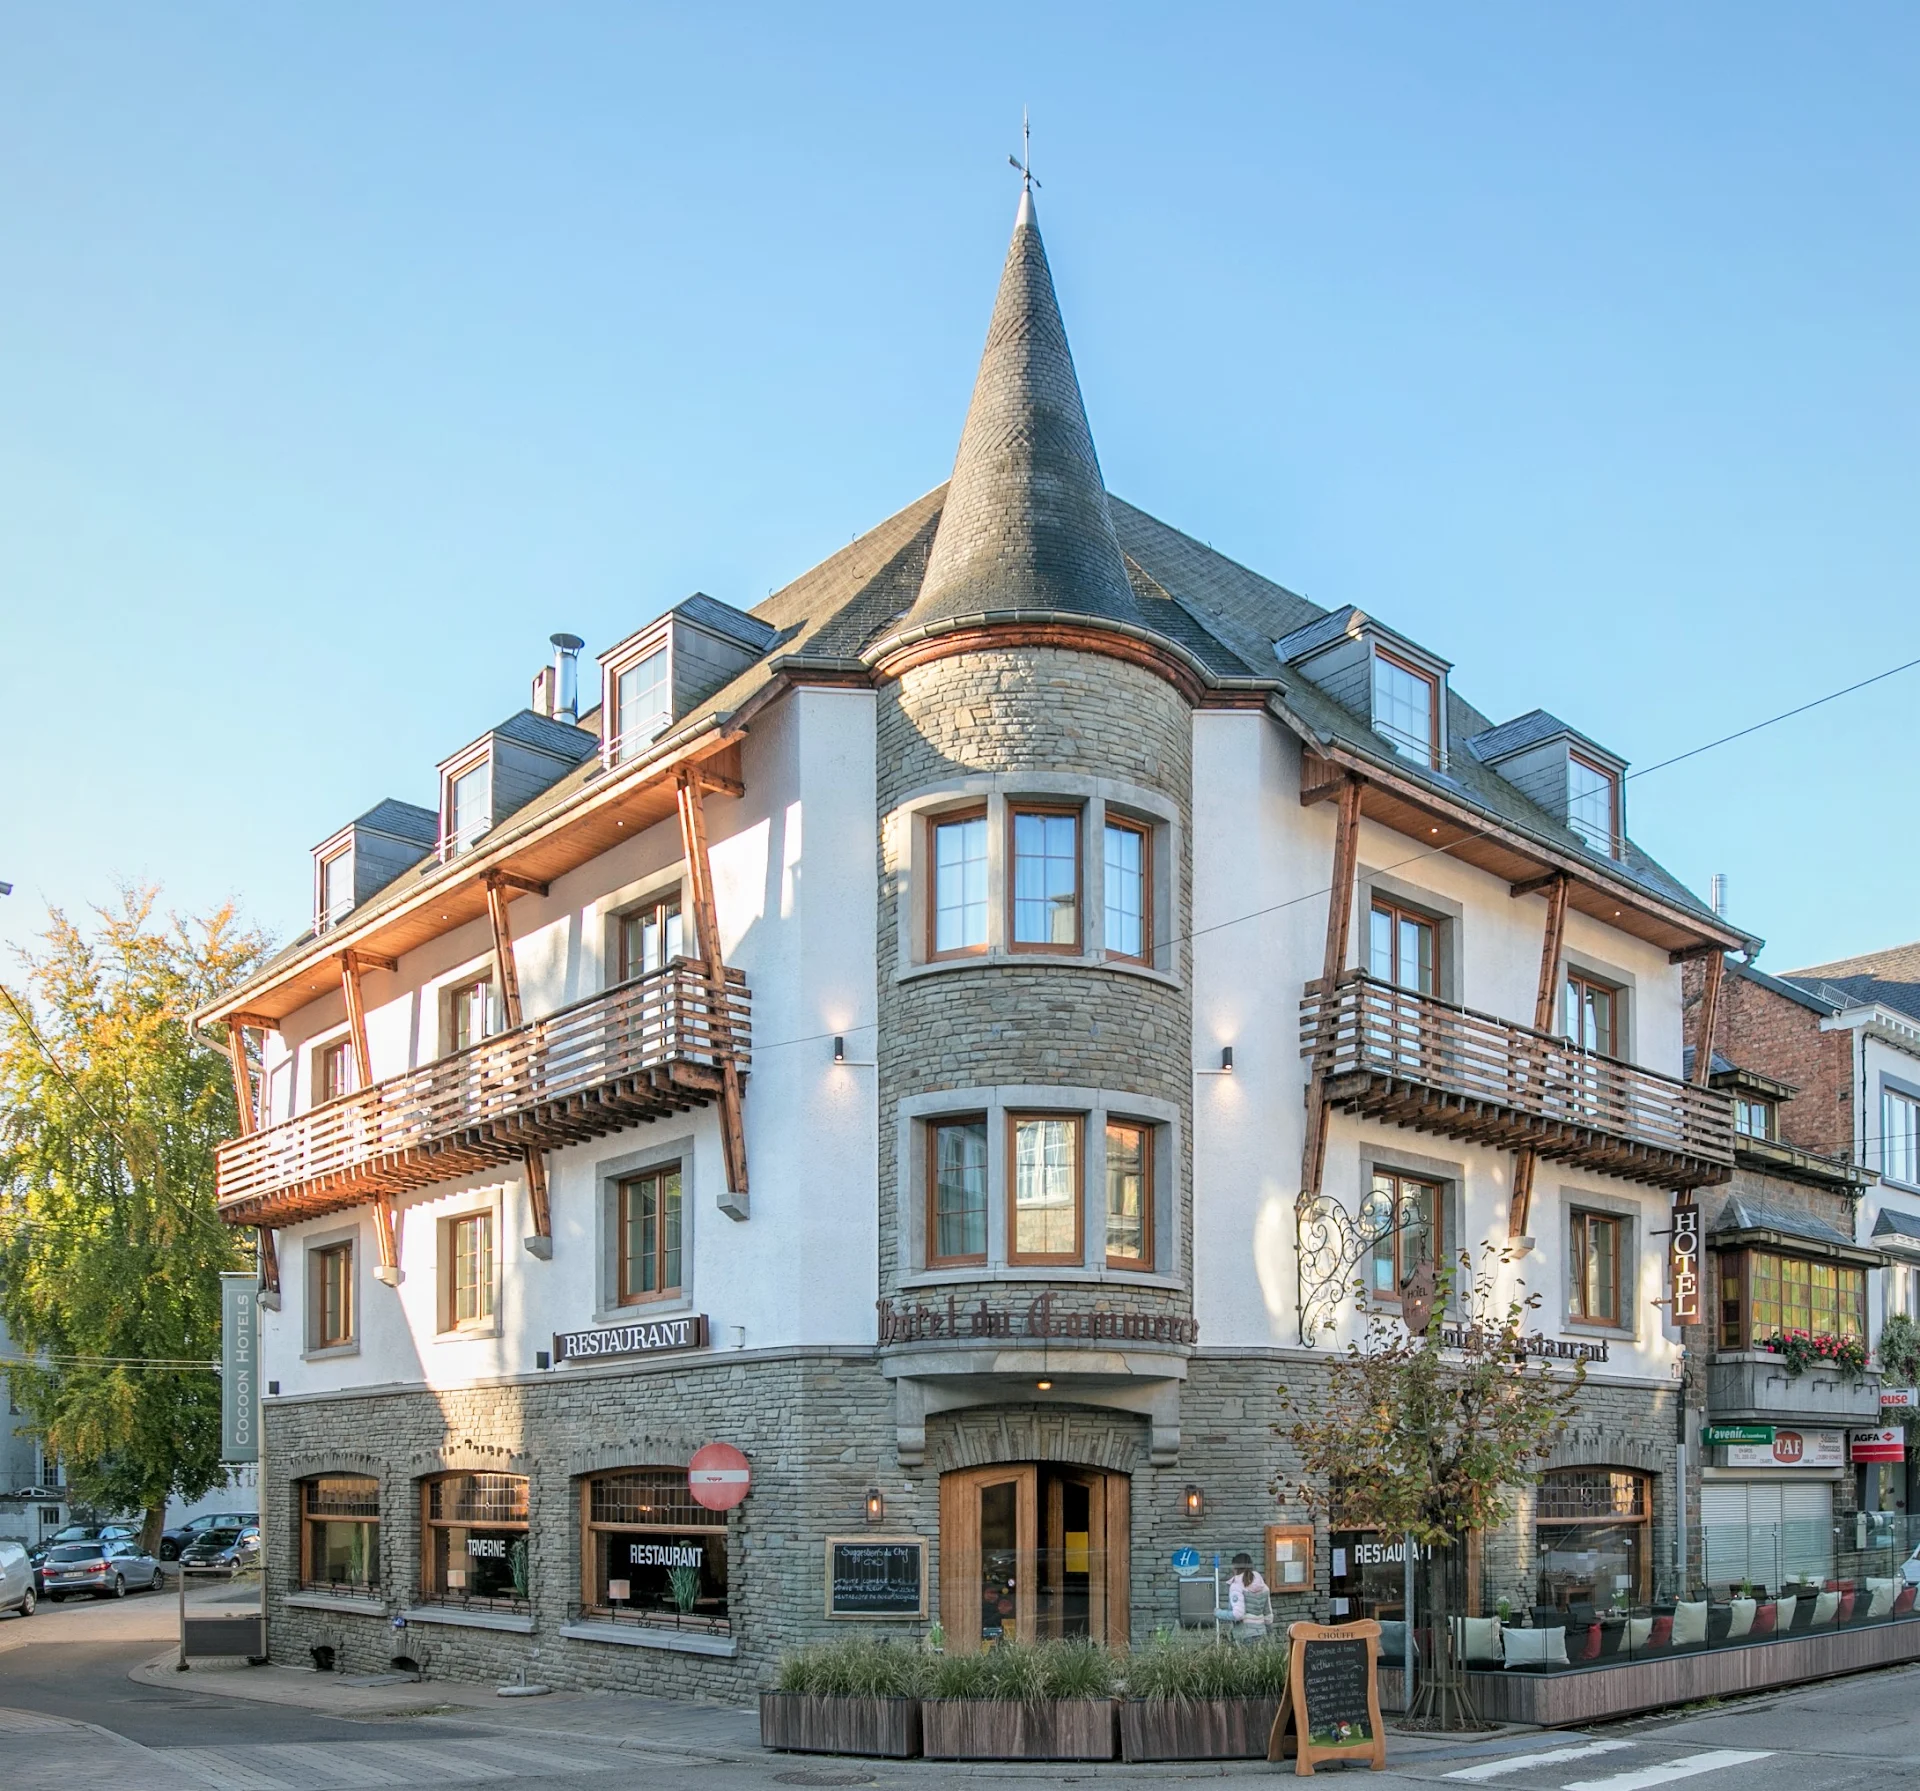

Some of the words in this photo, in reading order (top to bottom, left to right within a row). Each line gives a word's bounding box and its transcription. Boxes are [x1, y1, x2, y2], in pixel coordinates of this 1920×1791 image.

[1674, 1212, 1697, 1316] HOTEL
[971, 1301, 1011, 1338] du
[1028, 1291, 1200, 1344] Commerce
[236, 1294, 249, 1363] HOTELS
[564, 1320, 689, 1358] RESTAURANT
[236, 1369, 249, 1445] COCOON
[1881, 1394, 1908, 1404] euse
[1708, 1427, 1743, 1439] l'avenir
[1854, 1433, 1879, 1441] AGFA
[1776, 1438, 1801, 1455] TAF
[467, 1539, 506, 1558] TAVERNE
[630, 1544, 703, 1567] RESTAURANT
[1317, 1631, 1355, 1639] CHOUFFE
